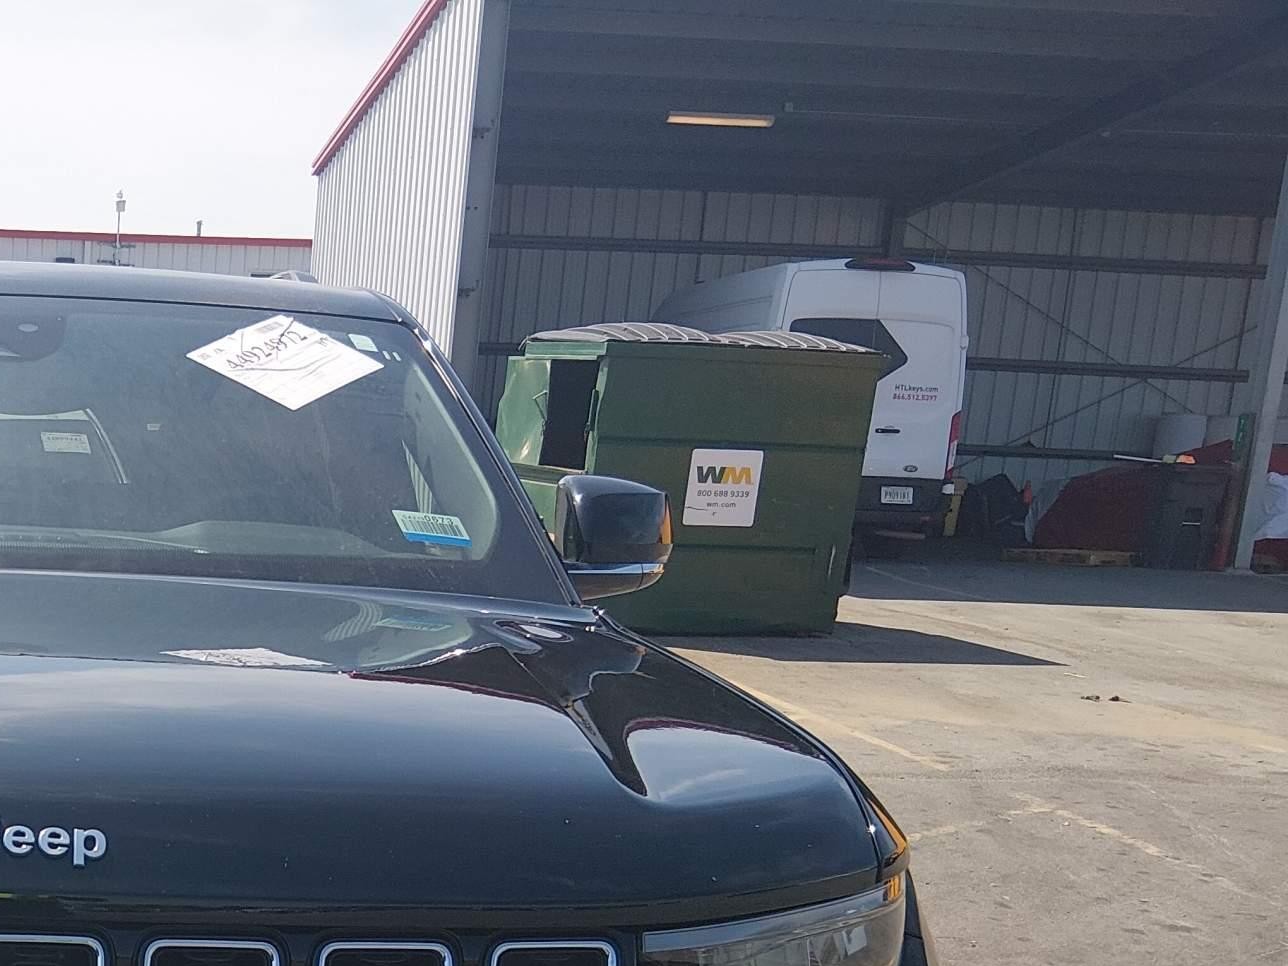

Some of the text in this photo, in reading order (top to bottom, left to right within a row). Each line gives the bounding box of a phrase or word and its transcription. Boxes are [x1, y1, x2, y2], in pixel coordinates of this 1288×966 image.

[697, 466, 752, 485] WM
[696, 489, 712, 497] 800
[730, 490, 750, 498] 9339
